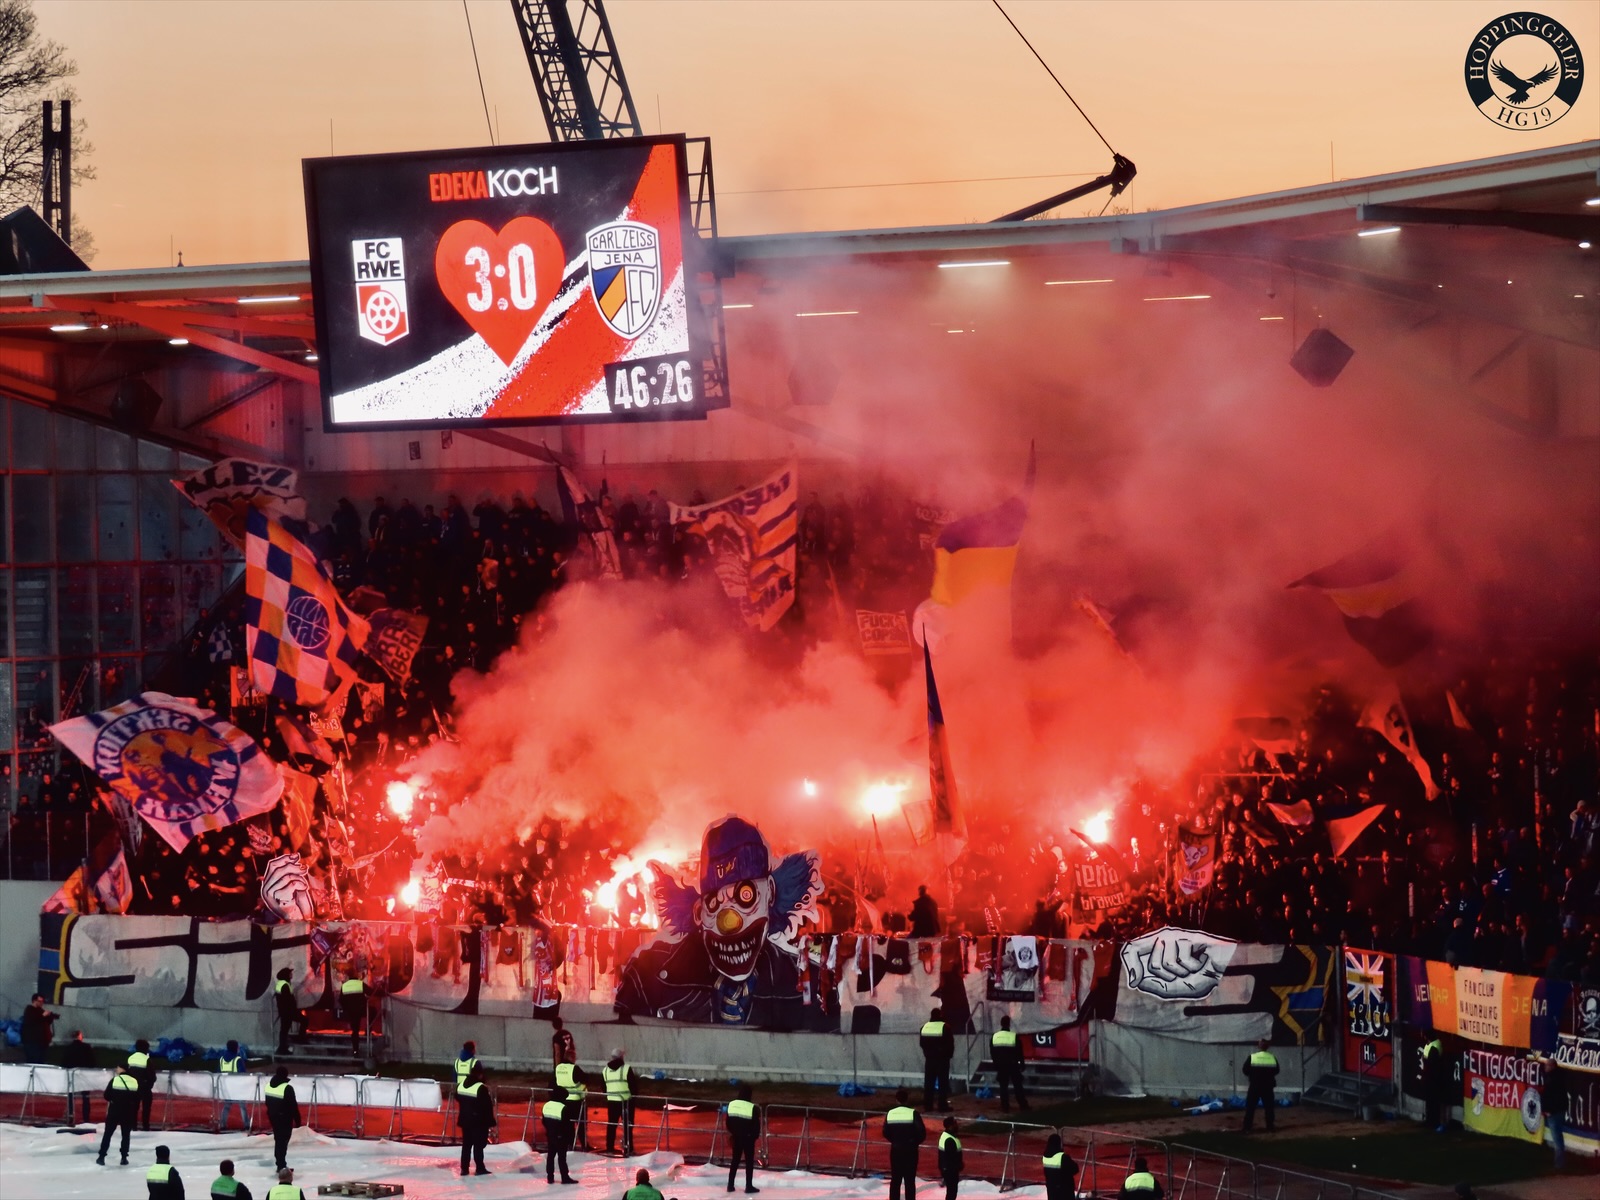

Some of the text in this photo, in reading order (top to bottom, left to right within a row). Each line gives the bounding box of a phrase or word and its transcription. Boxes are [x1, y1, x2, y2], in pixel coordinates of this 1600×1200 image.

[364, 241, 391, 259] FC
[604, 251, 643, 265] JENA
[357, 260, 402, 280] RWE
[464, 242, 538, 313] 3:0
[613, 359, 694, 409] 46:26
[1074, 863, 1119, 888] iena
[1080, 892, 1126, 911] branco
[1414, 984, 1448, 1006] WEIMAR
[1459, 1002, 1498, 1021] NAUMBURG
[1511, 996, 1548, 1017] JENA
[1459, 1019, 1480, 1034] UNITED
[1035, 1033, 1052, 1045] G1
[1487, 1081, 1520, 1109] GERA
